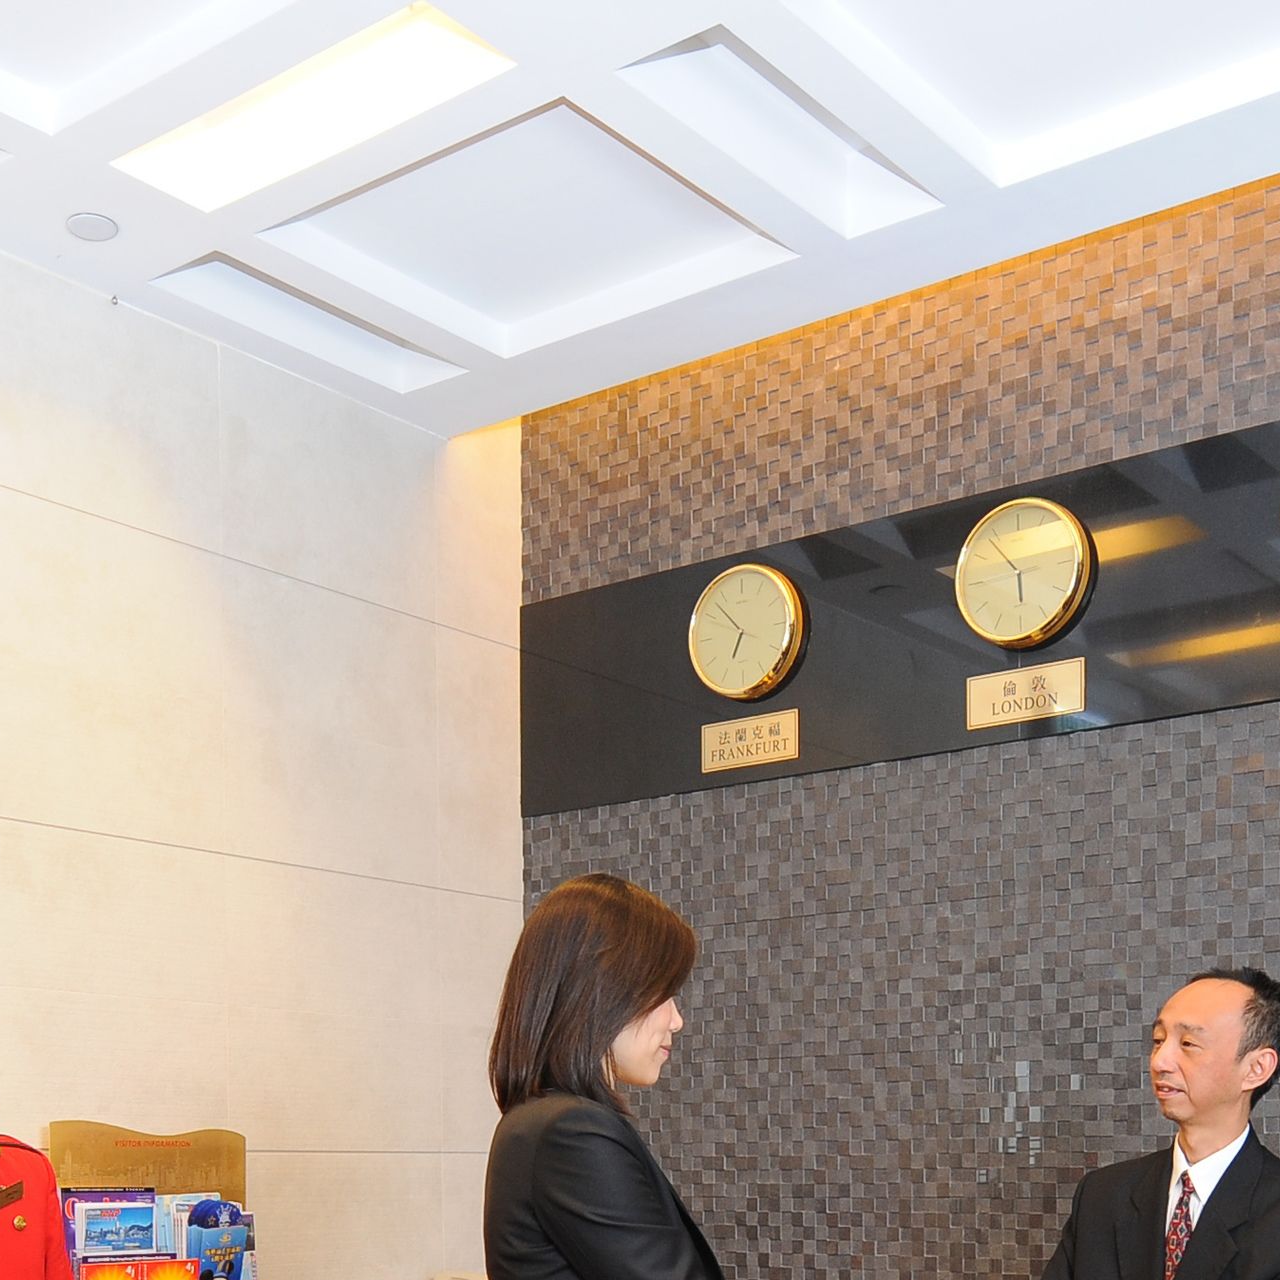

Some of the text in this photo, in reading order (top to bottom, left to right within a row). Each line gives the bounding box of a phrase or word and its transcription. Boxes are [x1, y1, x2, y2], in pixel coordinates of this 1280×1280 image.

[1003, 675, 1046, 697] 倫敦
[992, 692, 1058, 716] LONDON
[719, 721, 781, 746] 法蘭克福
[711, 737, 789, 762] FRANKFURT
